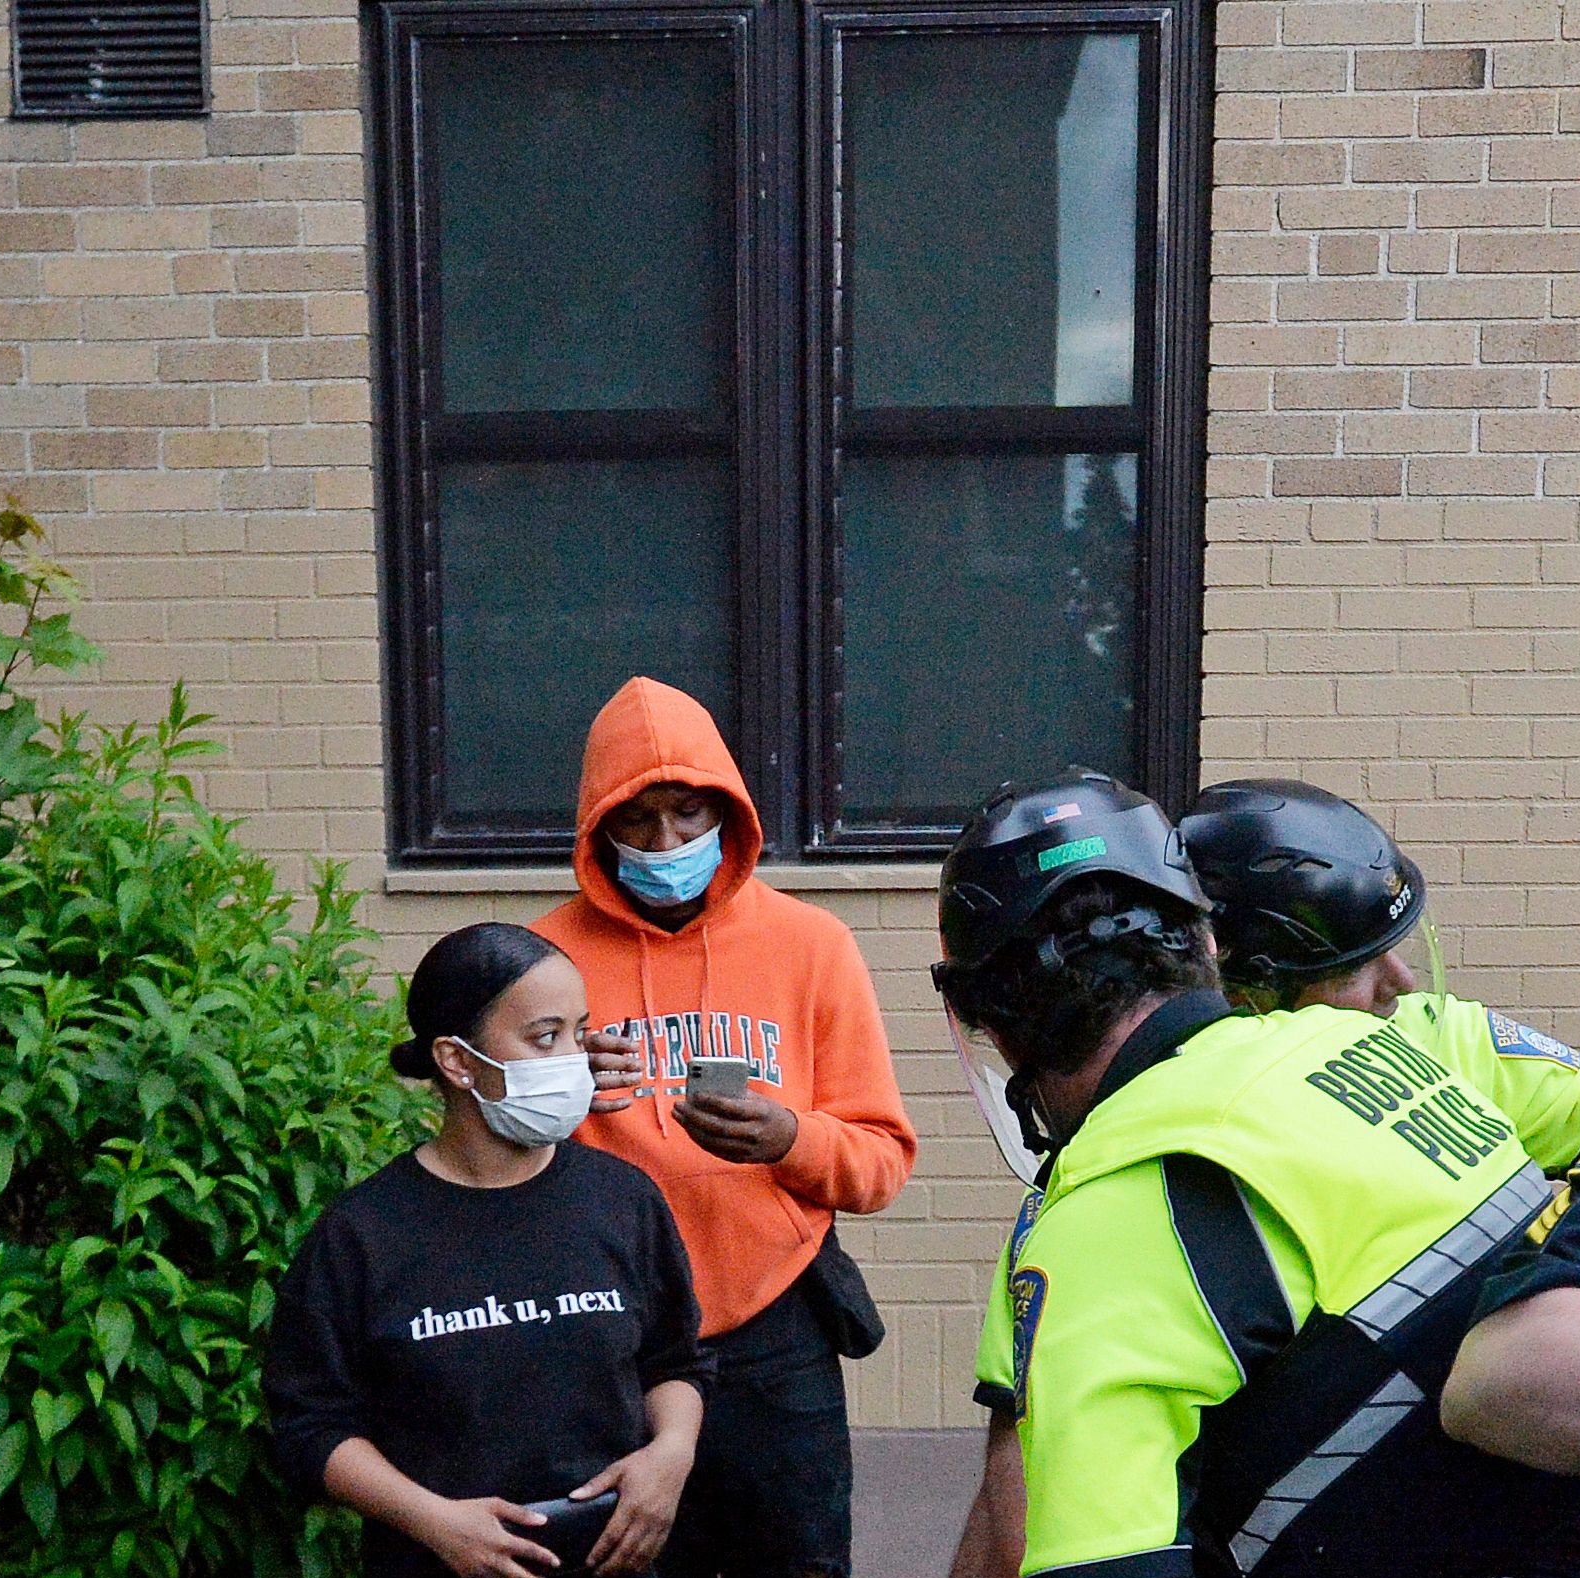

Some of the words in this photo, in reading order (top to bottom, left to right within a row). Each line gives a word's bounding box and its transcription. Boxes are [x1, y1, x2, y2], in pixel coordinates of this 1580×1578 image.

[1305, 1021, 1451, 1126] BOSTON
[1391, 1084, 1516, 1181] POLICE
[409, 1295, 513, 1340] thank
[513, 1298, 552, 1325] u,
[555, 1287, 626, 1317] next
